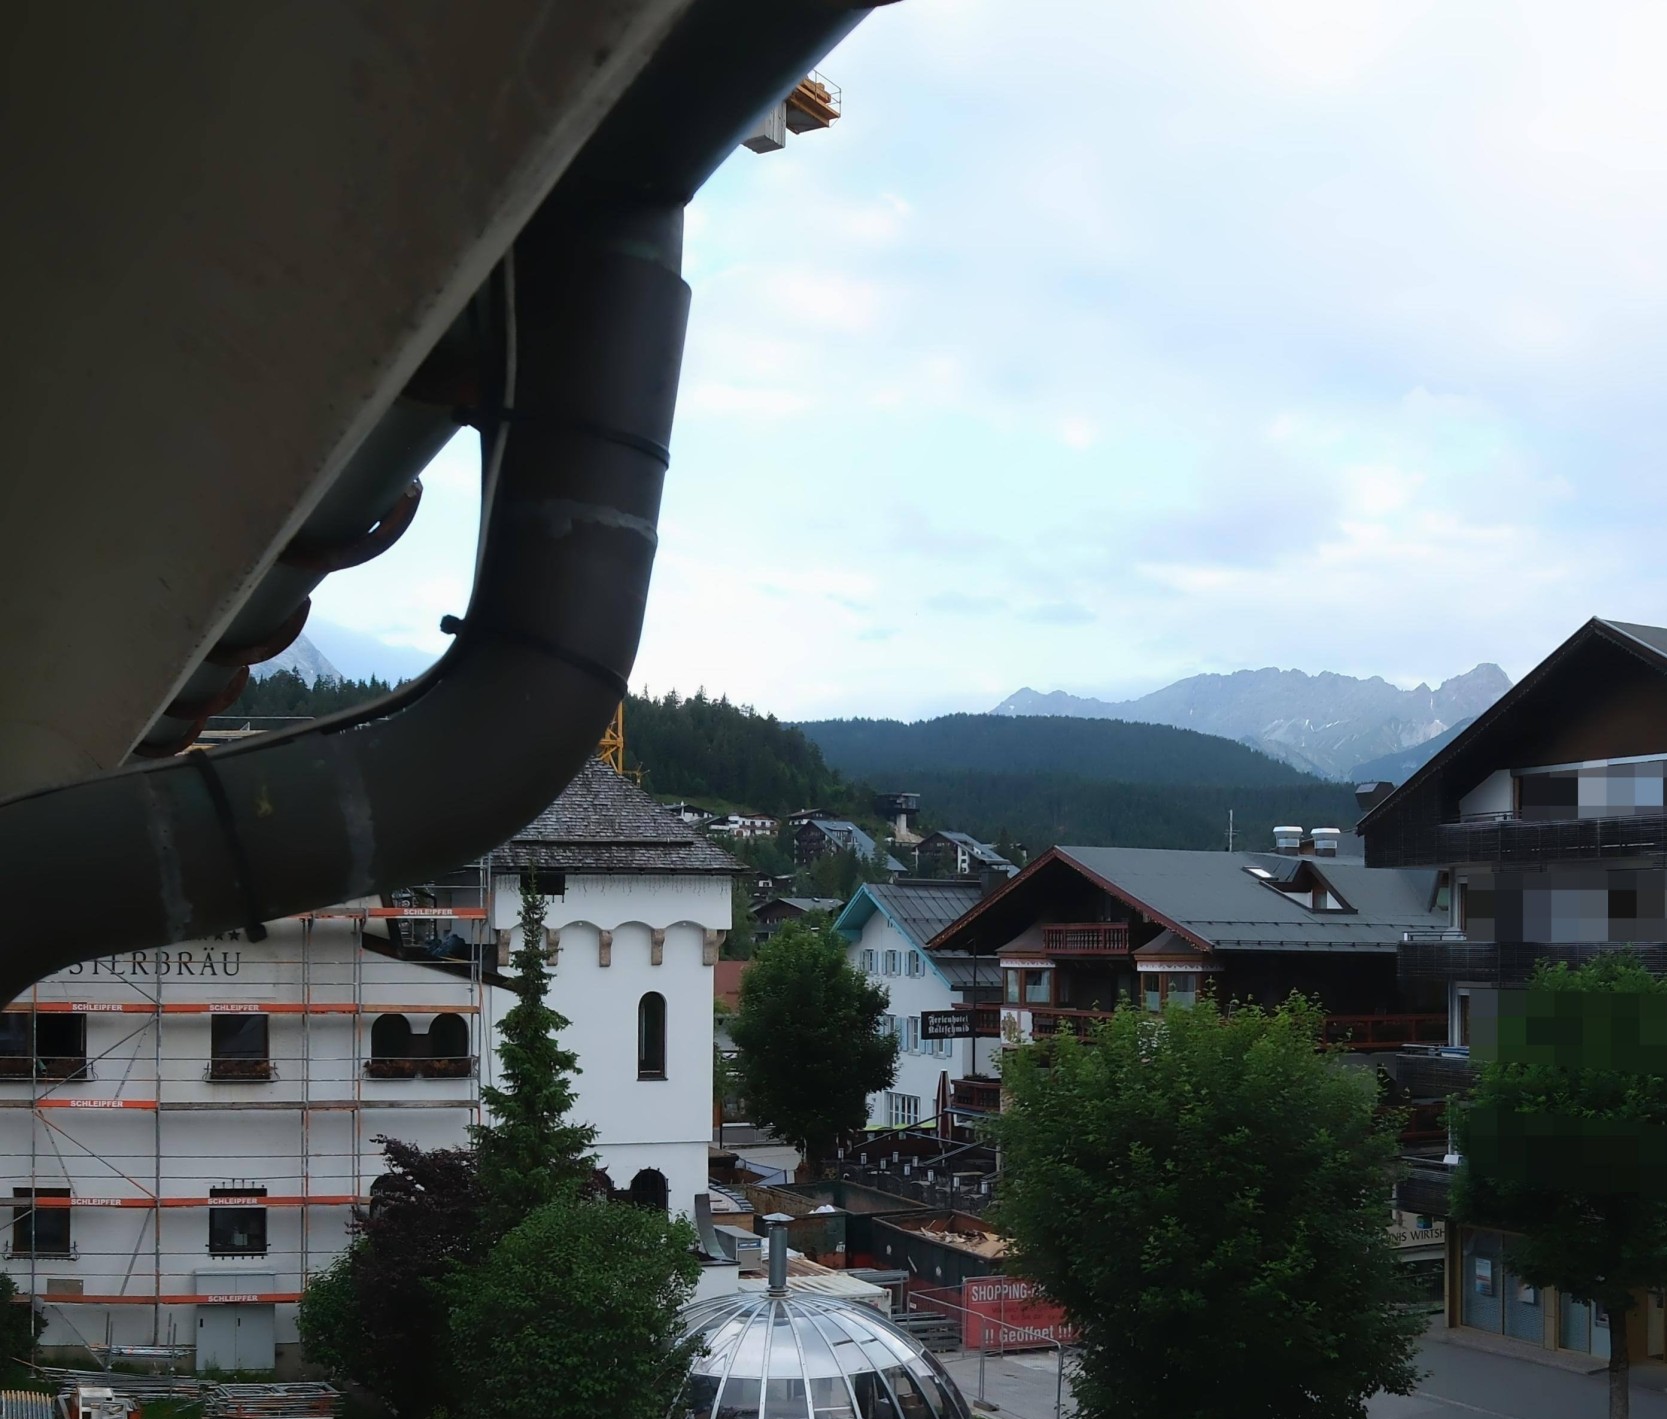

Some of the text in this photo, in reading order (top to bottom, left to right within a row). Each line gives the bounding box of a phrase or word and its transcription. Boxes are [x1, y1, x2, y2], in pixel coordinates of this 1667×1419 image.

[72, 1003, 122, 1012] SCHLEIPFER
[209, 1003, 259, 1012] SCHLEIPFER
[72, 1100, 124, 1108] SCHLEIPFER
[72, 1198, 122, 1206] SCHLEIPFER
[208, 1197, 258, 1205] SCHLEIPFER
[208, 1295, 258, 1303] SCHLEIPFER
